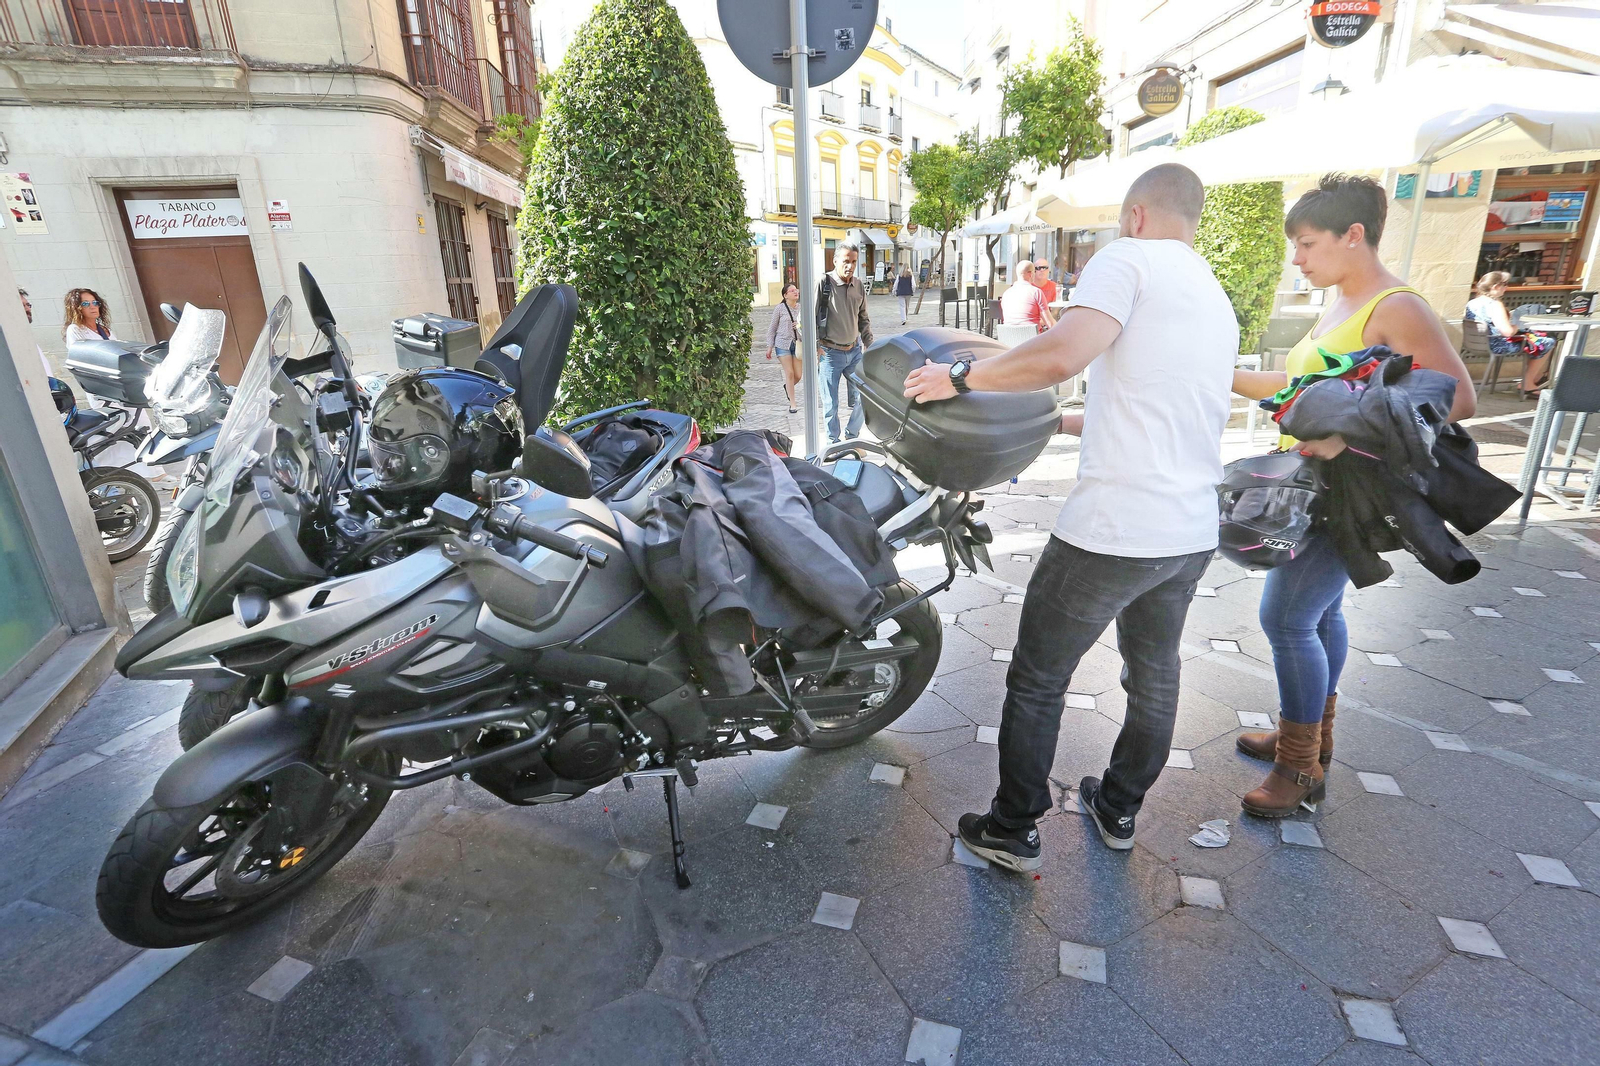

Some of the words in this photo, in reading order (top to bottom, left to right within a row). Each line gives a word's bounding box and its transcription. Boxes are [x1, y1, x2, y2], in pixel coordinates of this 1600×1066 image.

[1325, 2, 1370, 12] BODEGA
[1326, 14, 1361, 26] Estrella
[1325, 25, 1358, 37] Galicia
[1145, 84, 1177, 93] Estrella
[1146, 92, 1175, 102] Galicia
[159, 202, 216, 212] TABANCO
[135, 214, 179, 235] Plaza
[182, 213, 247, 228] Plateros
[1264, 539, 1295, 549] HJC
[326, 613, 441, 670] V-Strom
